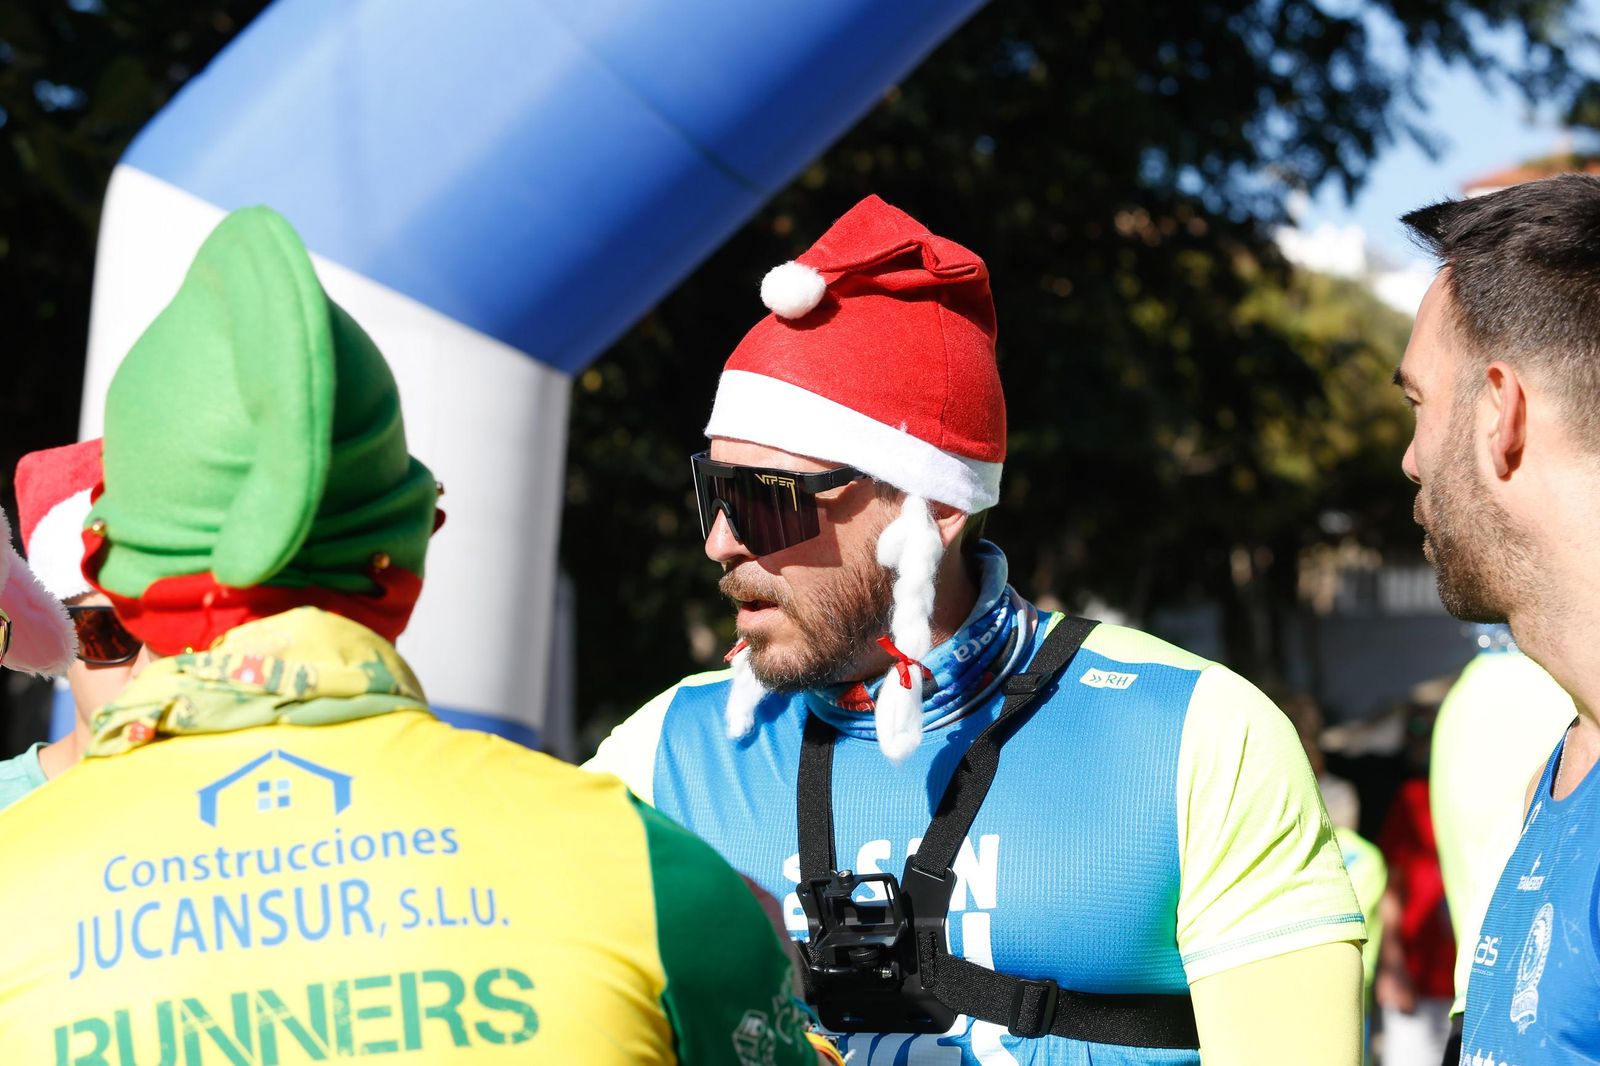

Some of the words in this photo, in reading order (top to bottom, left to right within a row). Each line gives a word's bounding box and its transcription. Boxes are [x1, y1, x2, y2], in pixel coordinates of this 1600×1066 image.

[1105, 673, 1129, 686] RH
[103, 827, 459, 893] Construcciones
[69, 878, 388, 980] JUCANSUR,
[399, 887, 510, 930] S.L.U.
[53, 967, 540, 1066] RUNNERS
